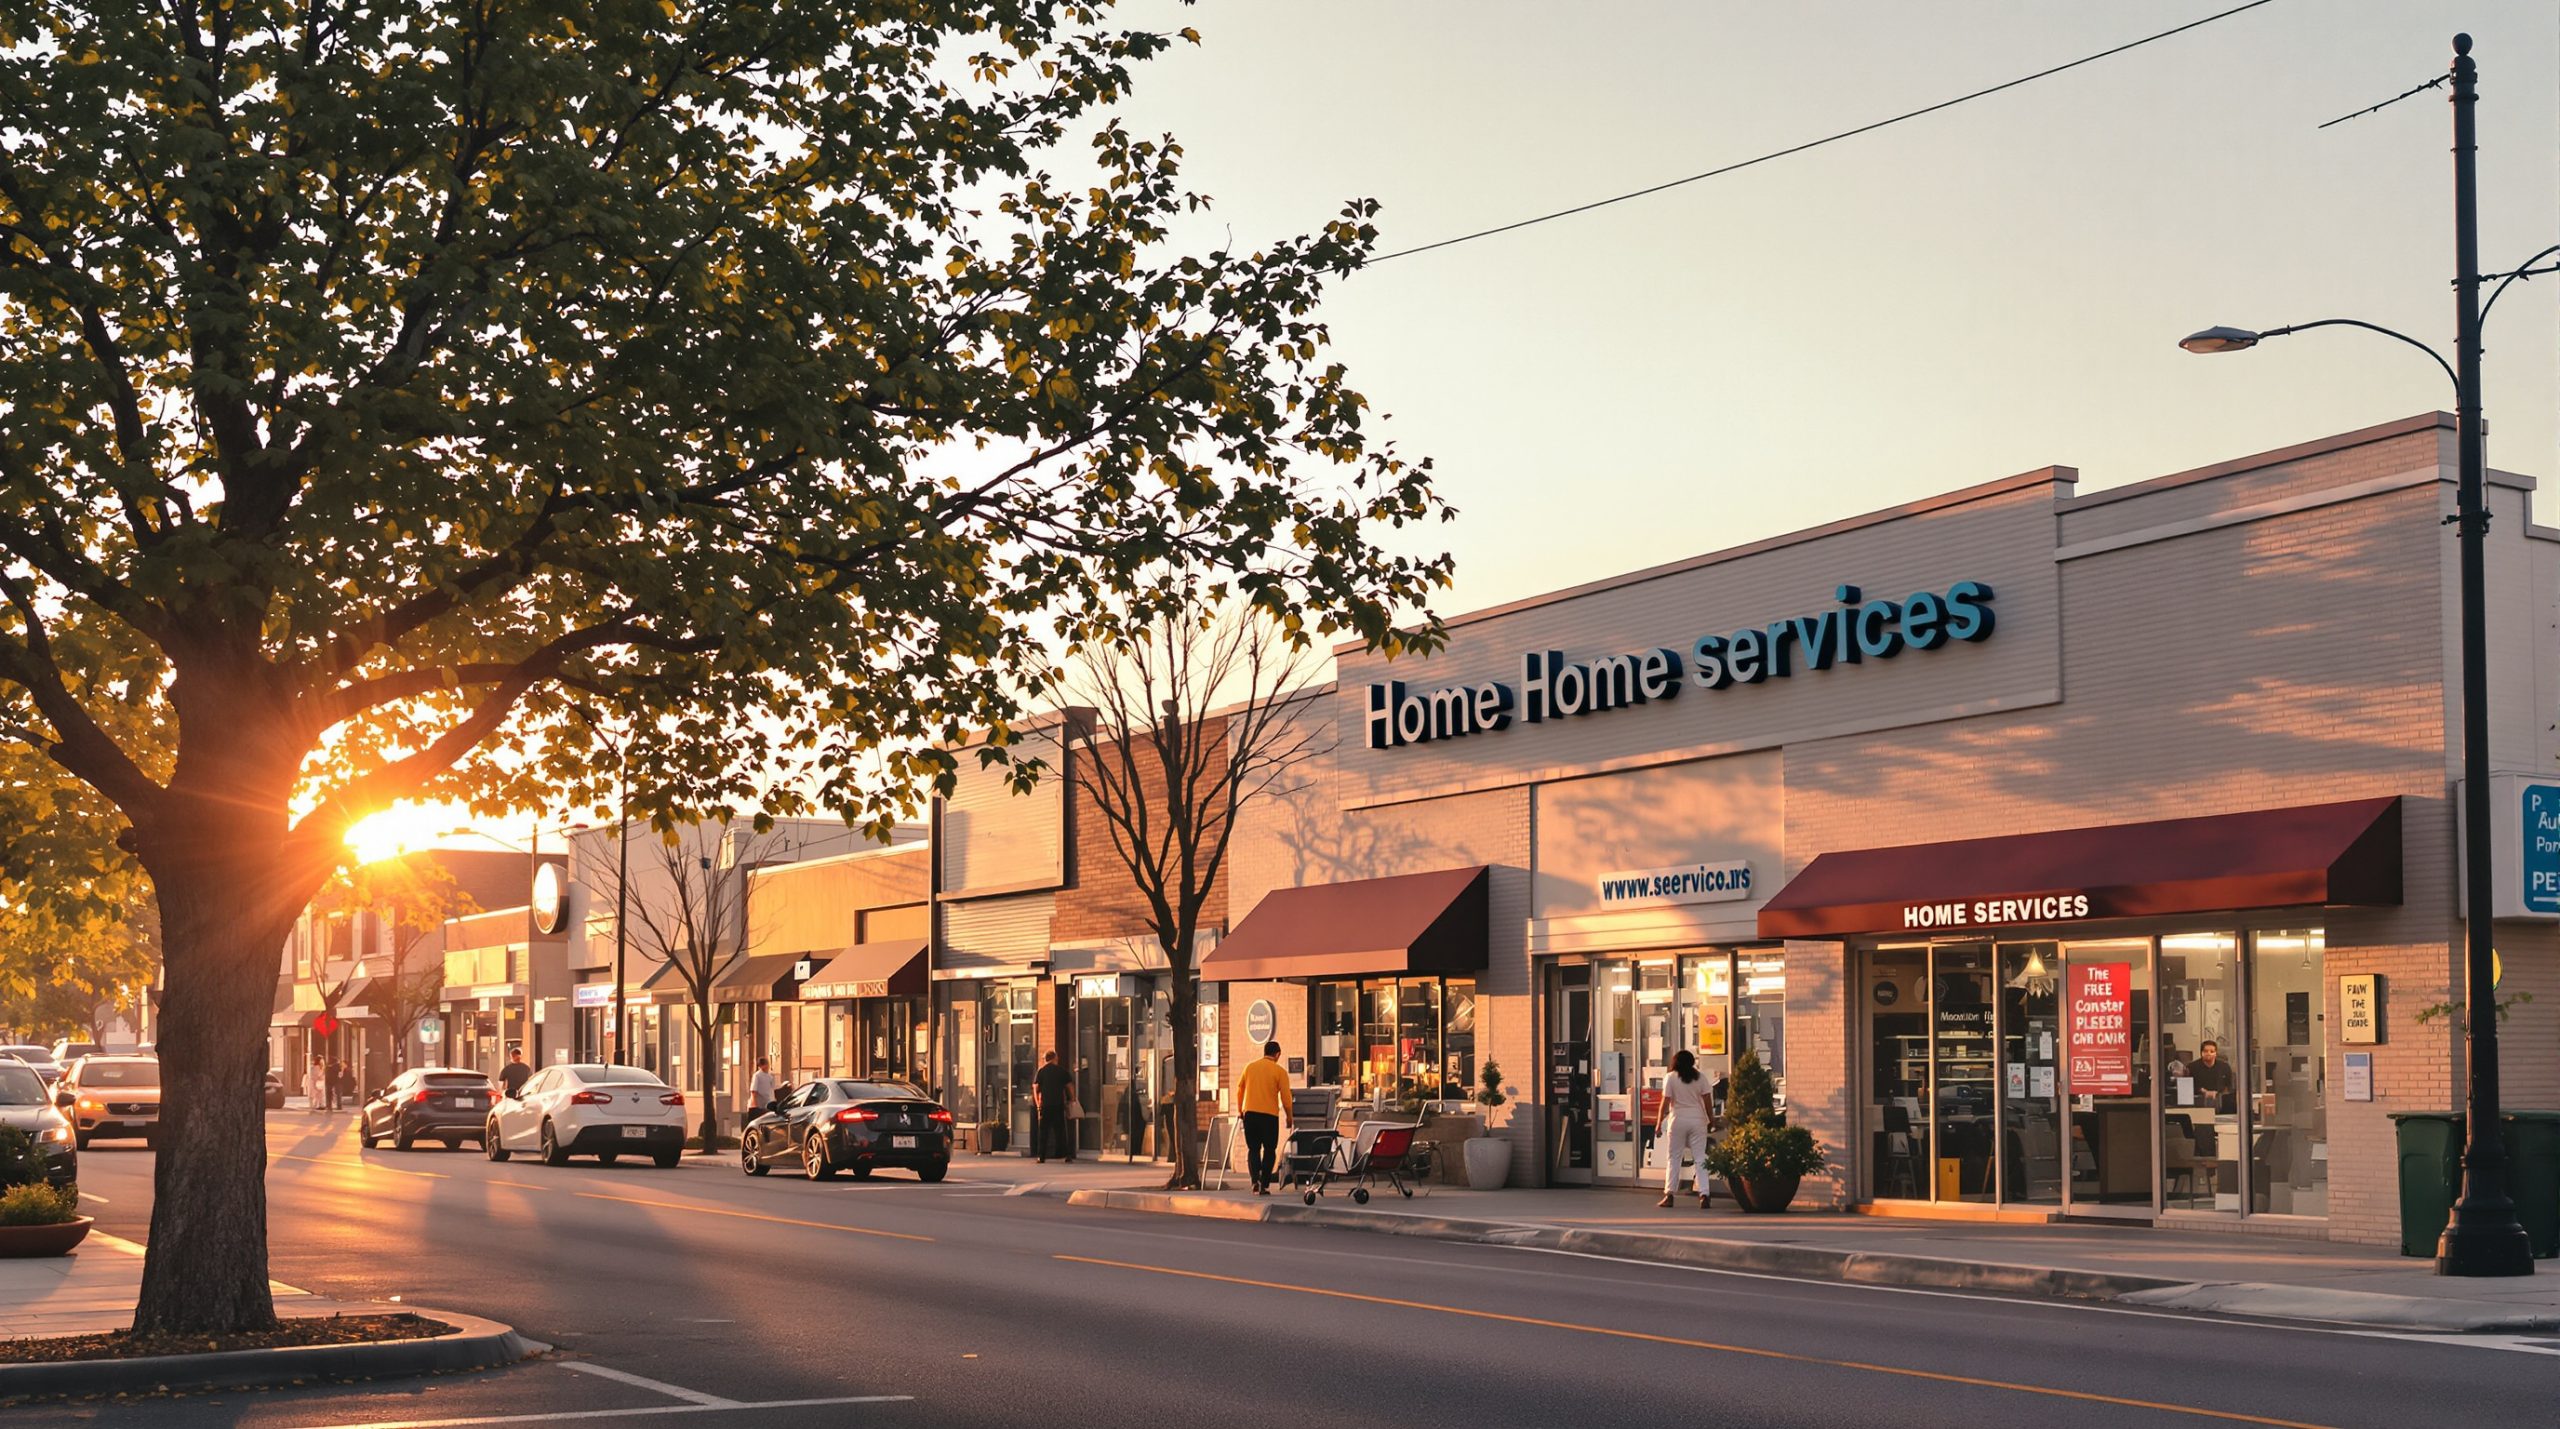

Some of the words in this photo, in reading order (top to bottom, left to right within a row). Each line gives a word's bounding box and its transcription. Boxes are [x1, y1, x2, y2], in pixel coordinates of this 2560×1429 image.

[1364, 680, 1513, 749] Home
[1520, 649, 1683, 723] Home
[1692, 581, 1996, 689] services
[2532, 872, 2560, 891] PE
[1904, 903, 1967, 928] HOME
[1974, 895, 2089, 923] SERVICES
[2084, 983, 2112, 996] FREE
